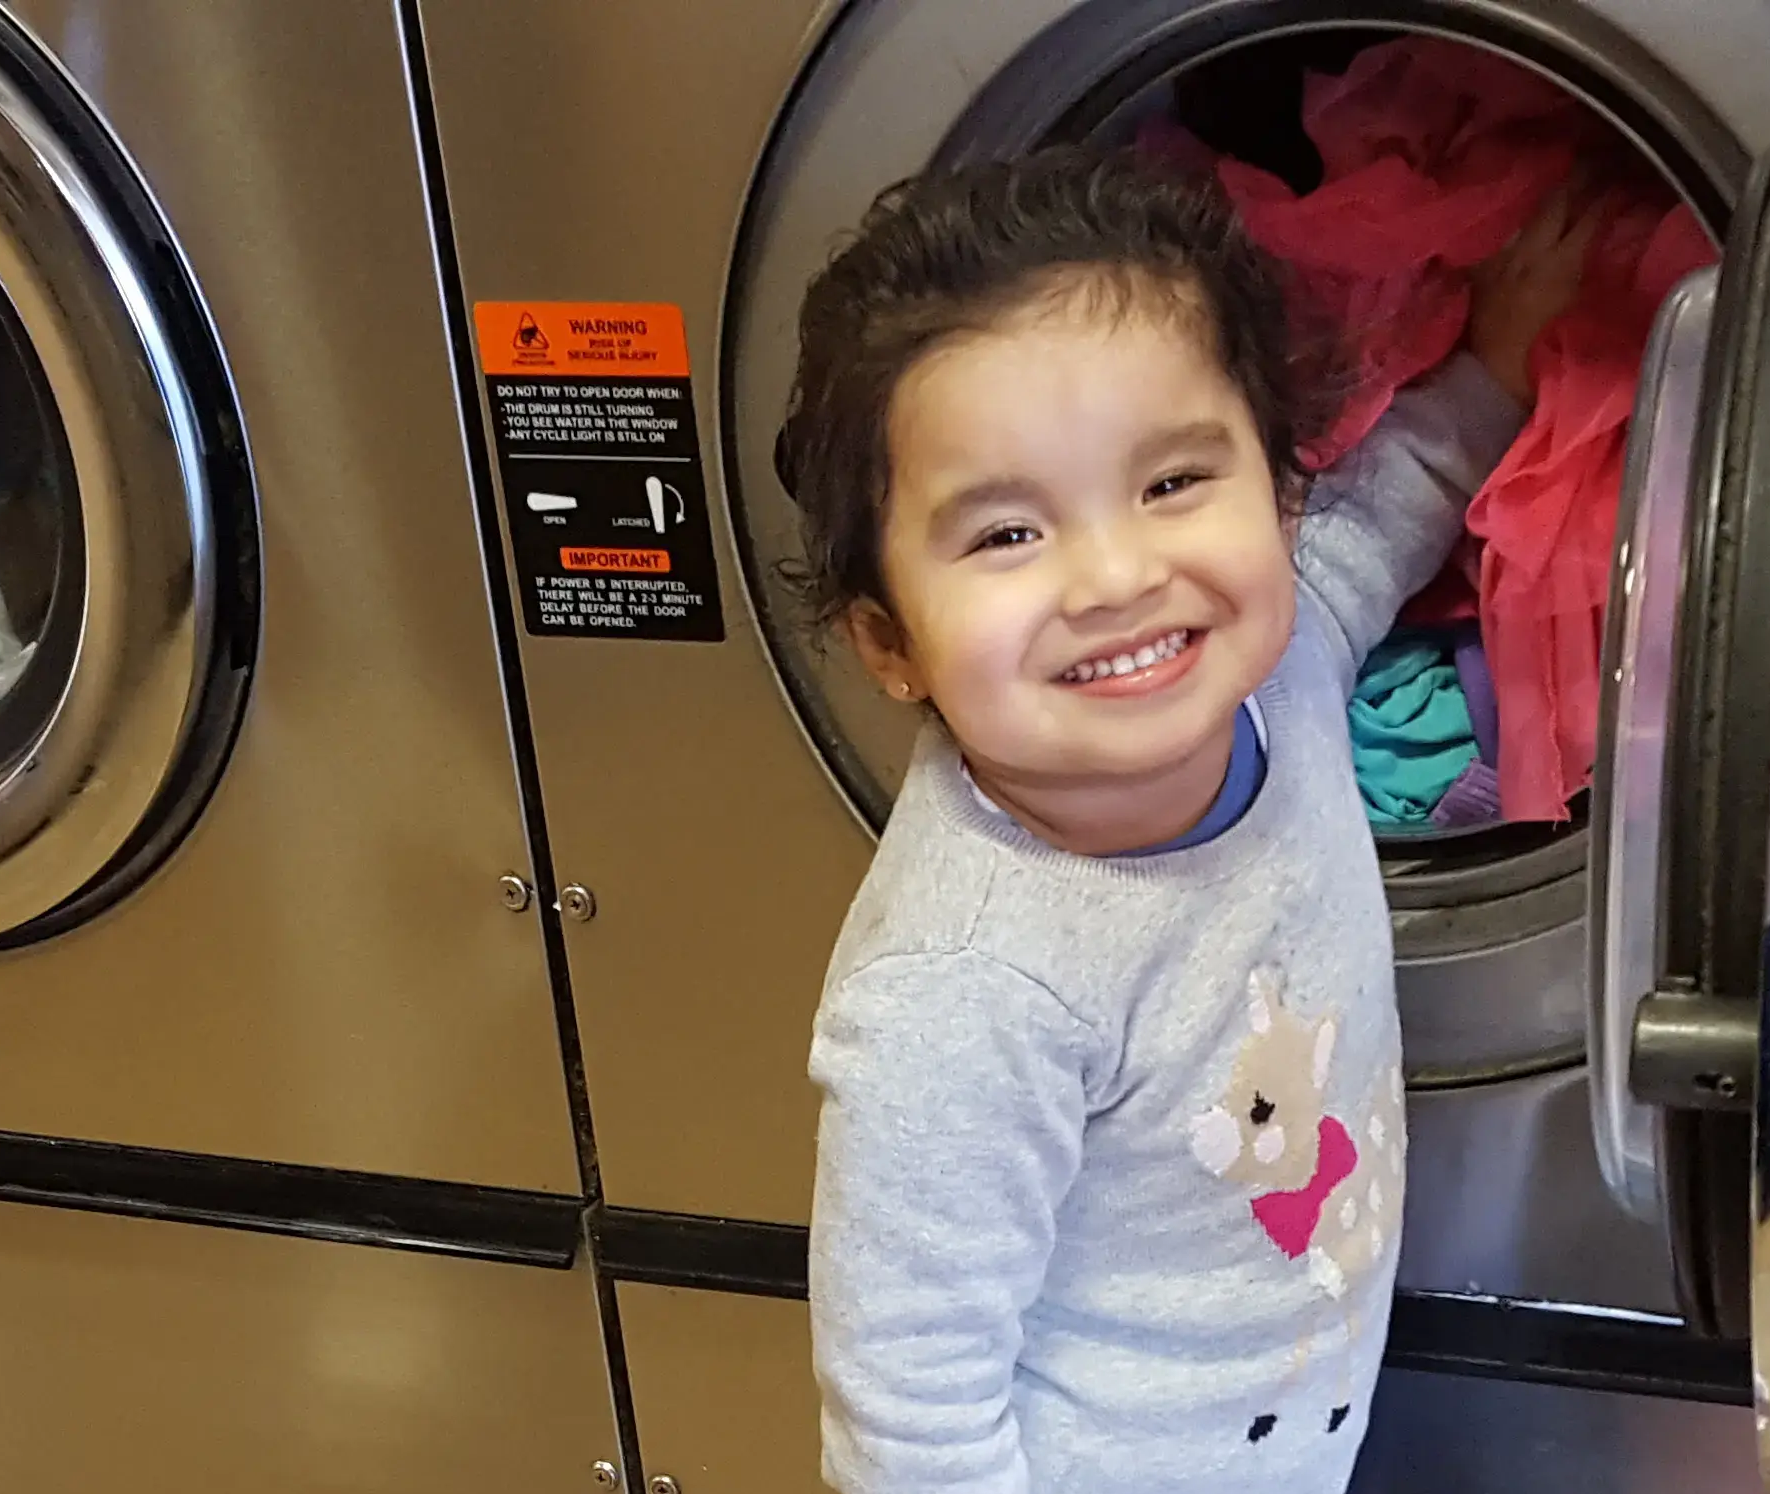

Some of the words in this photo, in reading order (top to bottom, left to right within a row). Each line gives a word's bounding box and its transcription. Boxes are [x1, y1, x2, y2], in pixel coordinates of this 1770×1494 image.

[569, 320, 647, 336] WARNING
[497, 385, 514, 397] DO
[515, 386, 537, 397] NOT
[540, 386, 561, 397] TRY
[563, 387, 578, 398] TO
[580, 387, 610, 398] OPEN
[612, 387, 644, 399] DOOR
[529, 403, 560, 415] DRUM
[561, 404, 573, 415] IS
[574, 404, 604, 416] STILL
[606, 404, 654, 416] TURNING
[532, 417, 554, 427] SEE
[555, 417, 593, 428] WATER
[595, 418, 605, 428] IN
[607, 418, 629, 429] THE
[631, 418, 678, 430] WINDOW
[533, 429, 569, 441] CYCLE
[571, 430, 601, 441] LIGHT
[604, 431, 615, 442] IS
[617, 431, 647, 443] STILL
[649, 431, 665, 443] ON
[543, 516, 566, 525] OPEN
[612, 517, 650, 528] LATCHED
[569, 552, 661, 568] IMPORTANT
[535, 577, 546, 587] IF
[551, 577, 590, 589] POWER
[595, 579, 606, 589] IS
[538, 590, 574, 601] THERE
[579, 591, 604, 602] WILL
[609, 592, 624, 602] BE
[629, 593, 637, 603] A
[662, 594, 703, 606] MINUTE
[540, 601, 574, 613] DELAY
[579, 602, 622, 615] BEFORE
[628, 605, 649, 616] THE
[654, 605, 686, 617] DOOR
[542, 614, 566, 625] CAN
[570, 616, 585, 626] BE
